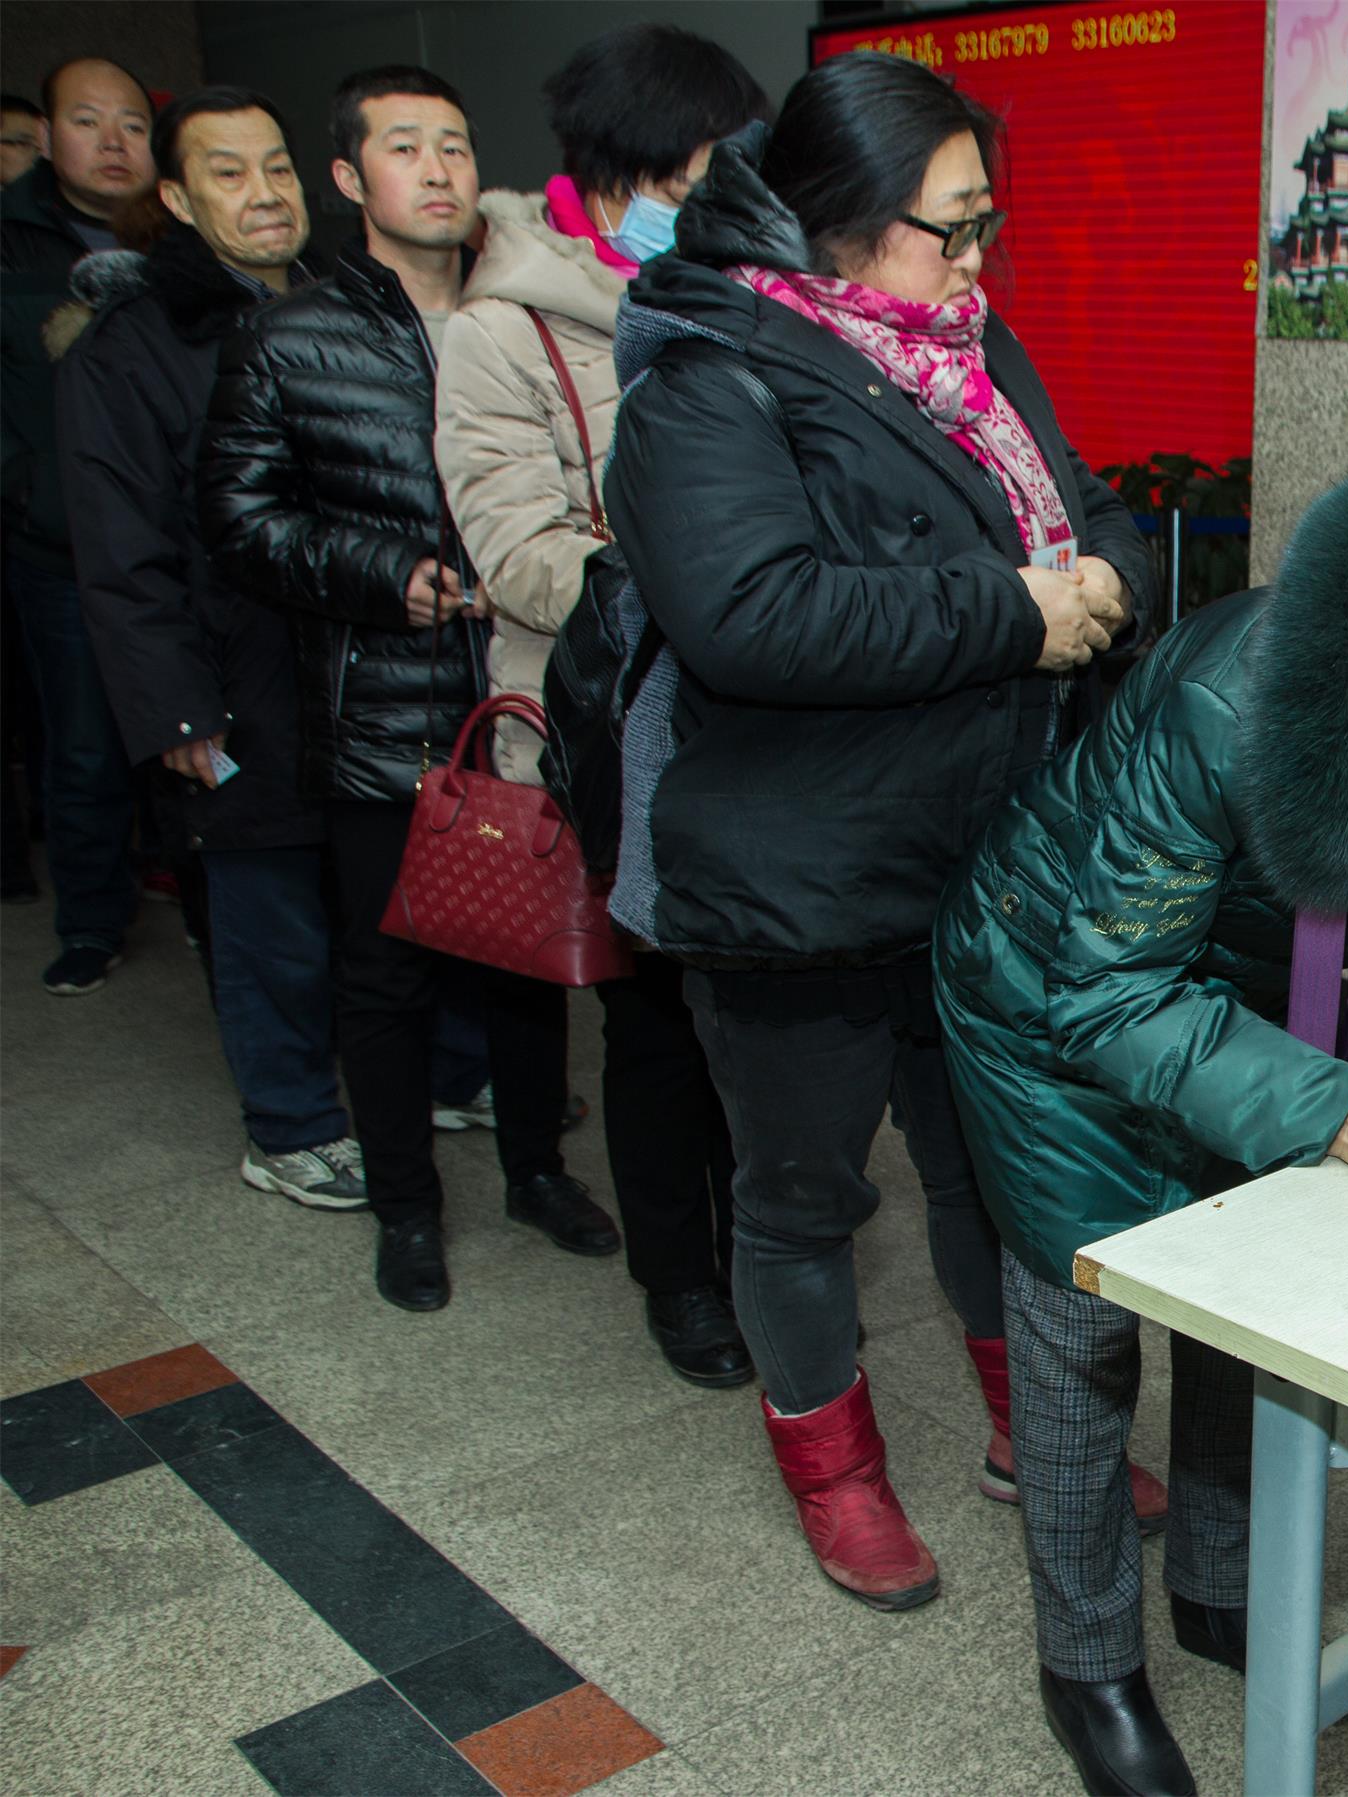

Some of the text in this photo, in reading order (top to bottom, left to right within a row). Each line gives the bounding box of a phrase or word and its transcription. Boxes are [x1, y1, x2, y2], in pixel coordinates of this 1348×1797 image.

[954, 22, 1049, 63] 33167979
[1071, 8, 1177, 52] 33160623
[1242, 258, 1258, 292] 2
